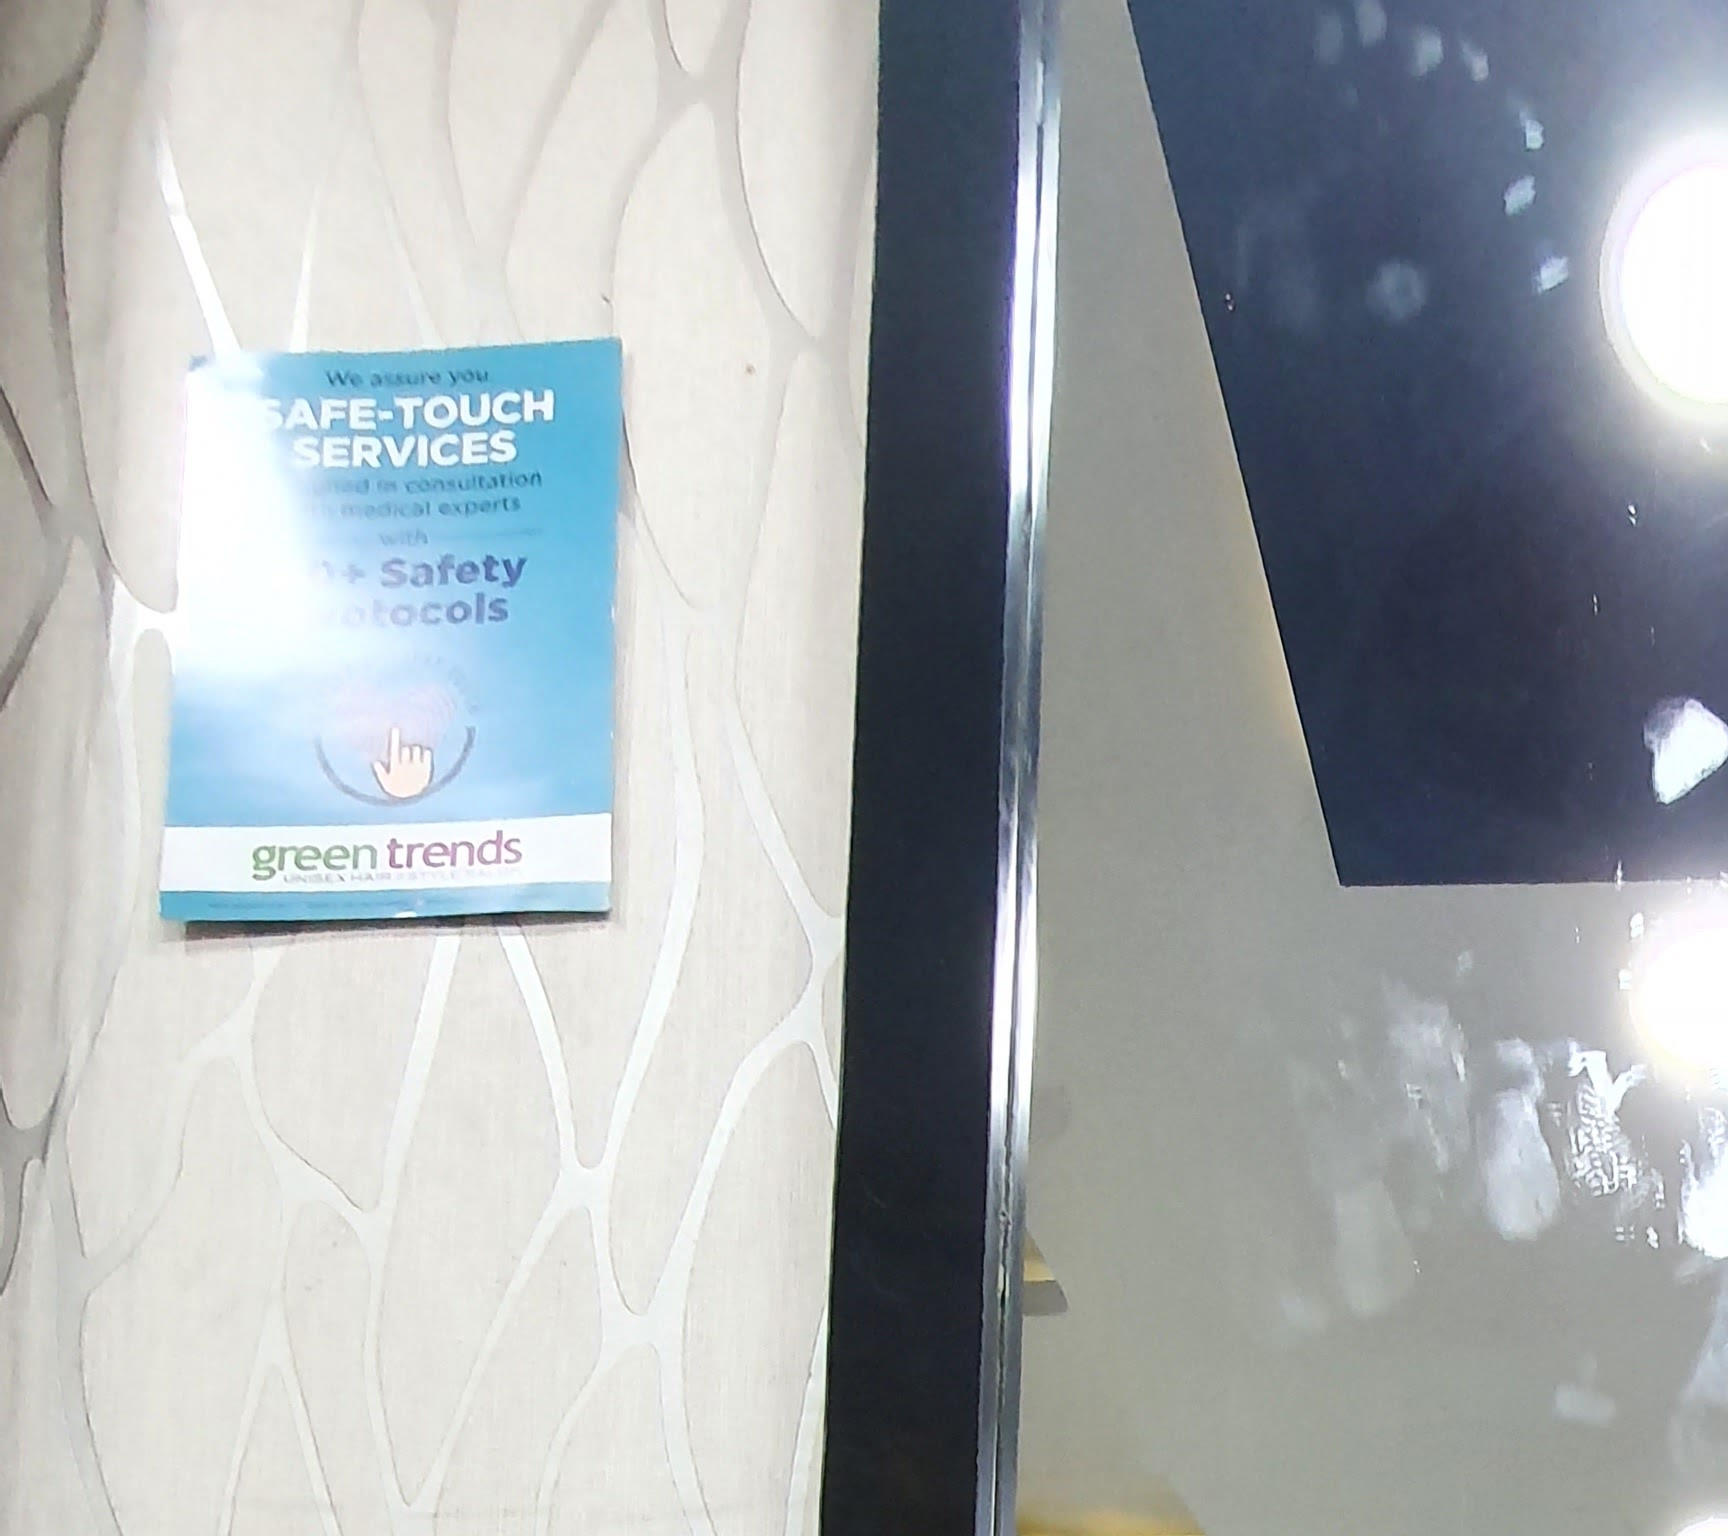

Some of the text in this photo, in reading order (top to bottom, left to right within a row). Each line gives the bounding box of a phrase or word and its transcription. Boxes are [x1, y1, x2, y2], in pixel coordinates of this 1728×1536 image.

[326, 369, 489, 388] We assure you
[262, 388, 555, 430] SAFE-TOUCH
[292, 430, 518, 468] SERVICES
[404, 470, 542, 494] consultation
[339, 499, 431, 518] medical
[438, 495, 521, 517] experts
[380, 553, 527, 588] Safety
[251, 830, 523, 881] green trends
